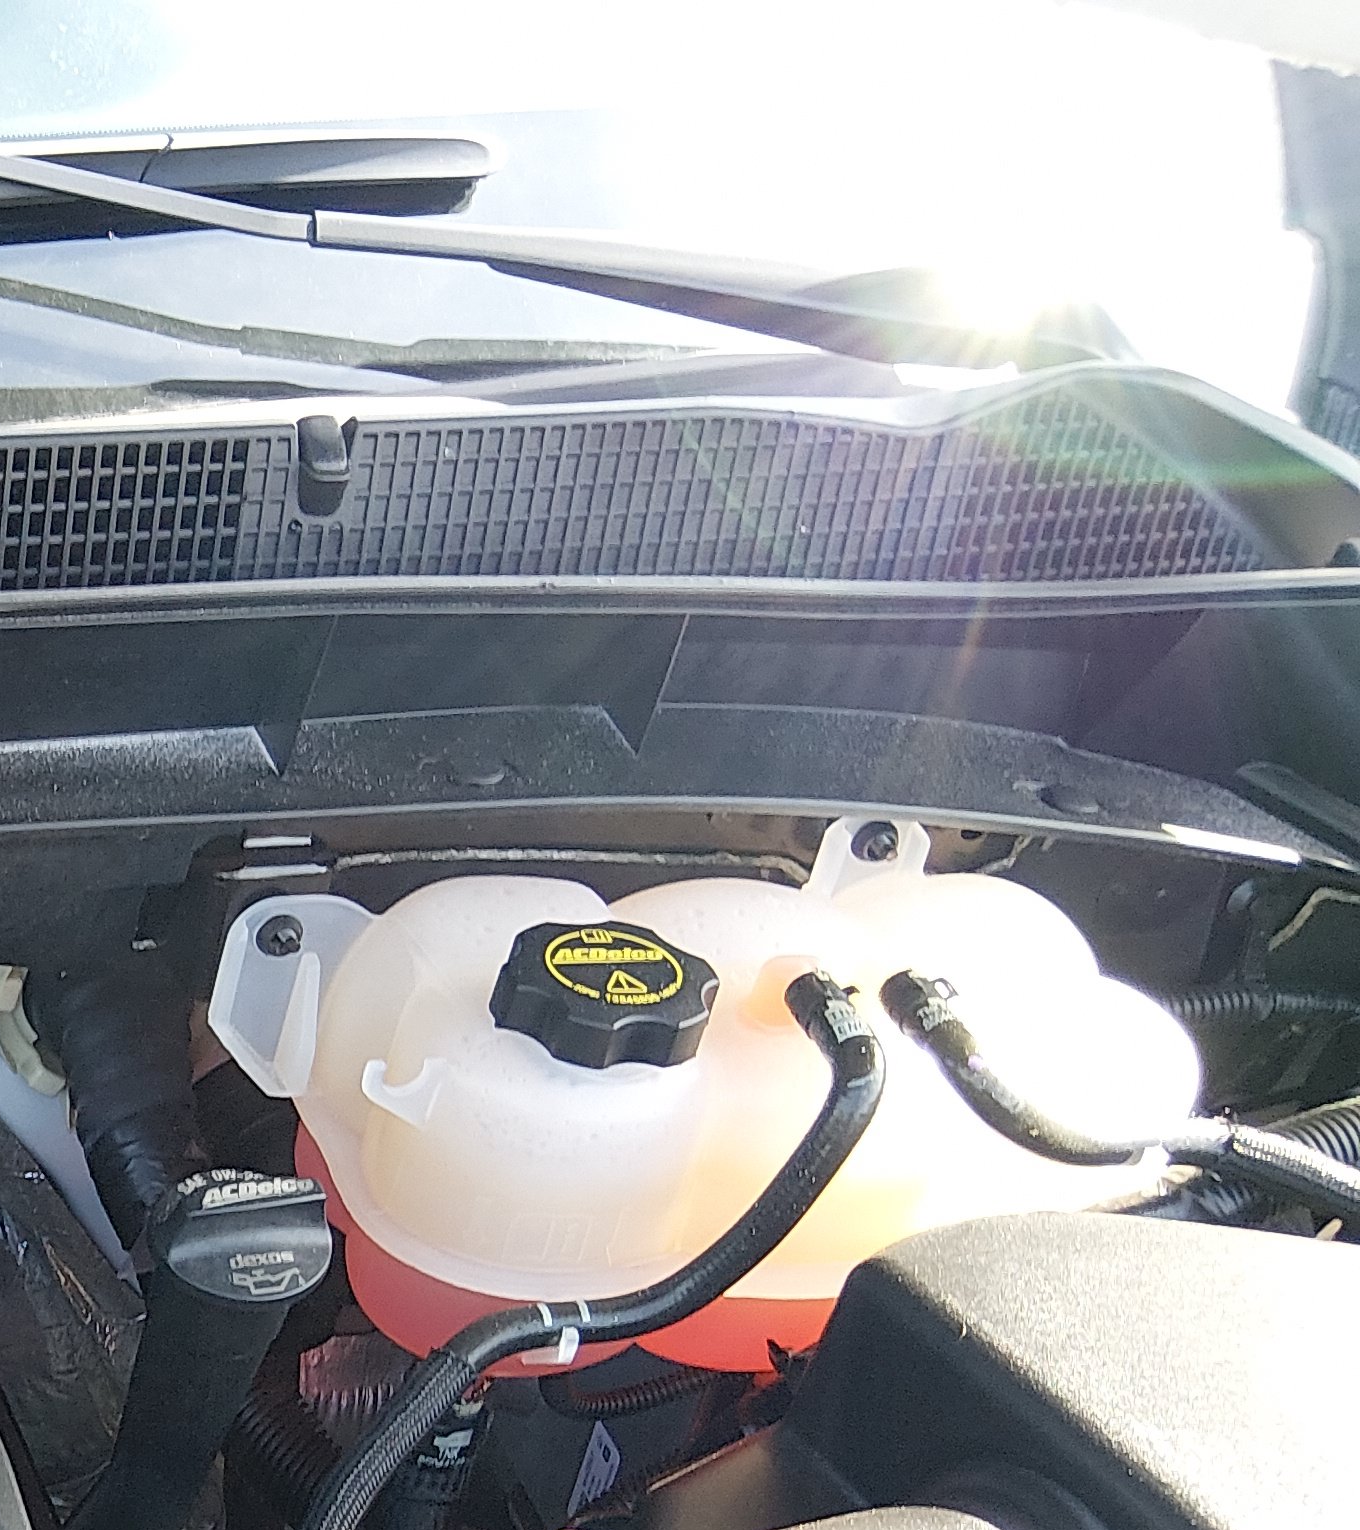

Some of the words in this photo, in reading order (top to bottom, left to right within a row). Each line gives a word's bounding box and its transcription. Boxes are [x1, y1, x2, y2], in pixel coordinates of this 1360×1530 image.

[552, 946, 663, 962] ACDelco
[202, 1177, 315, 1209] ACDelco
[229, 1250, 295, 1269] dexos
